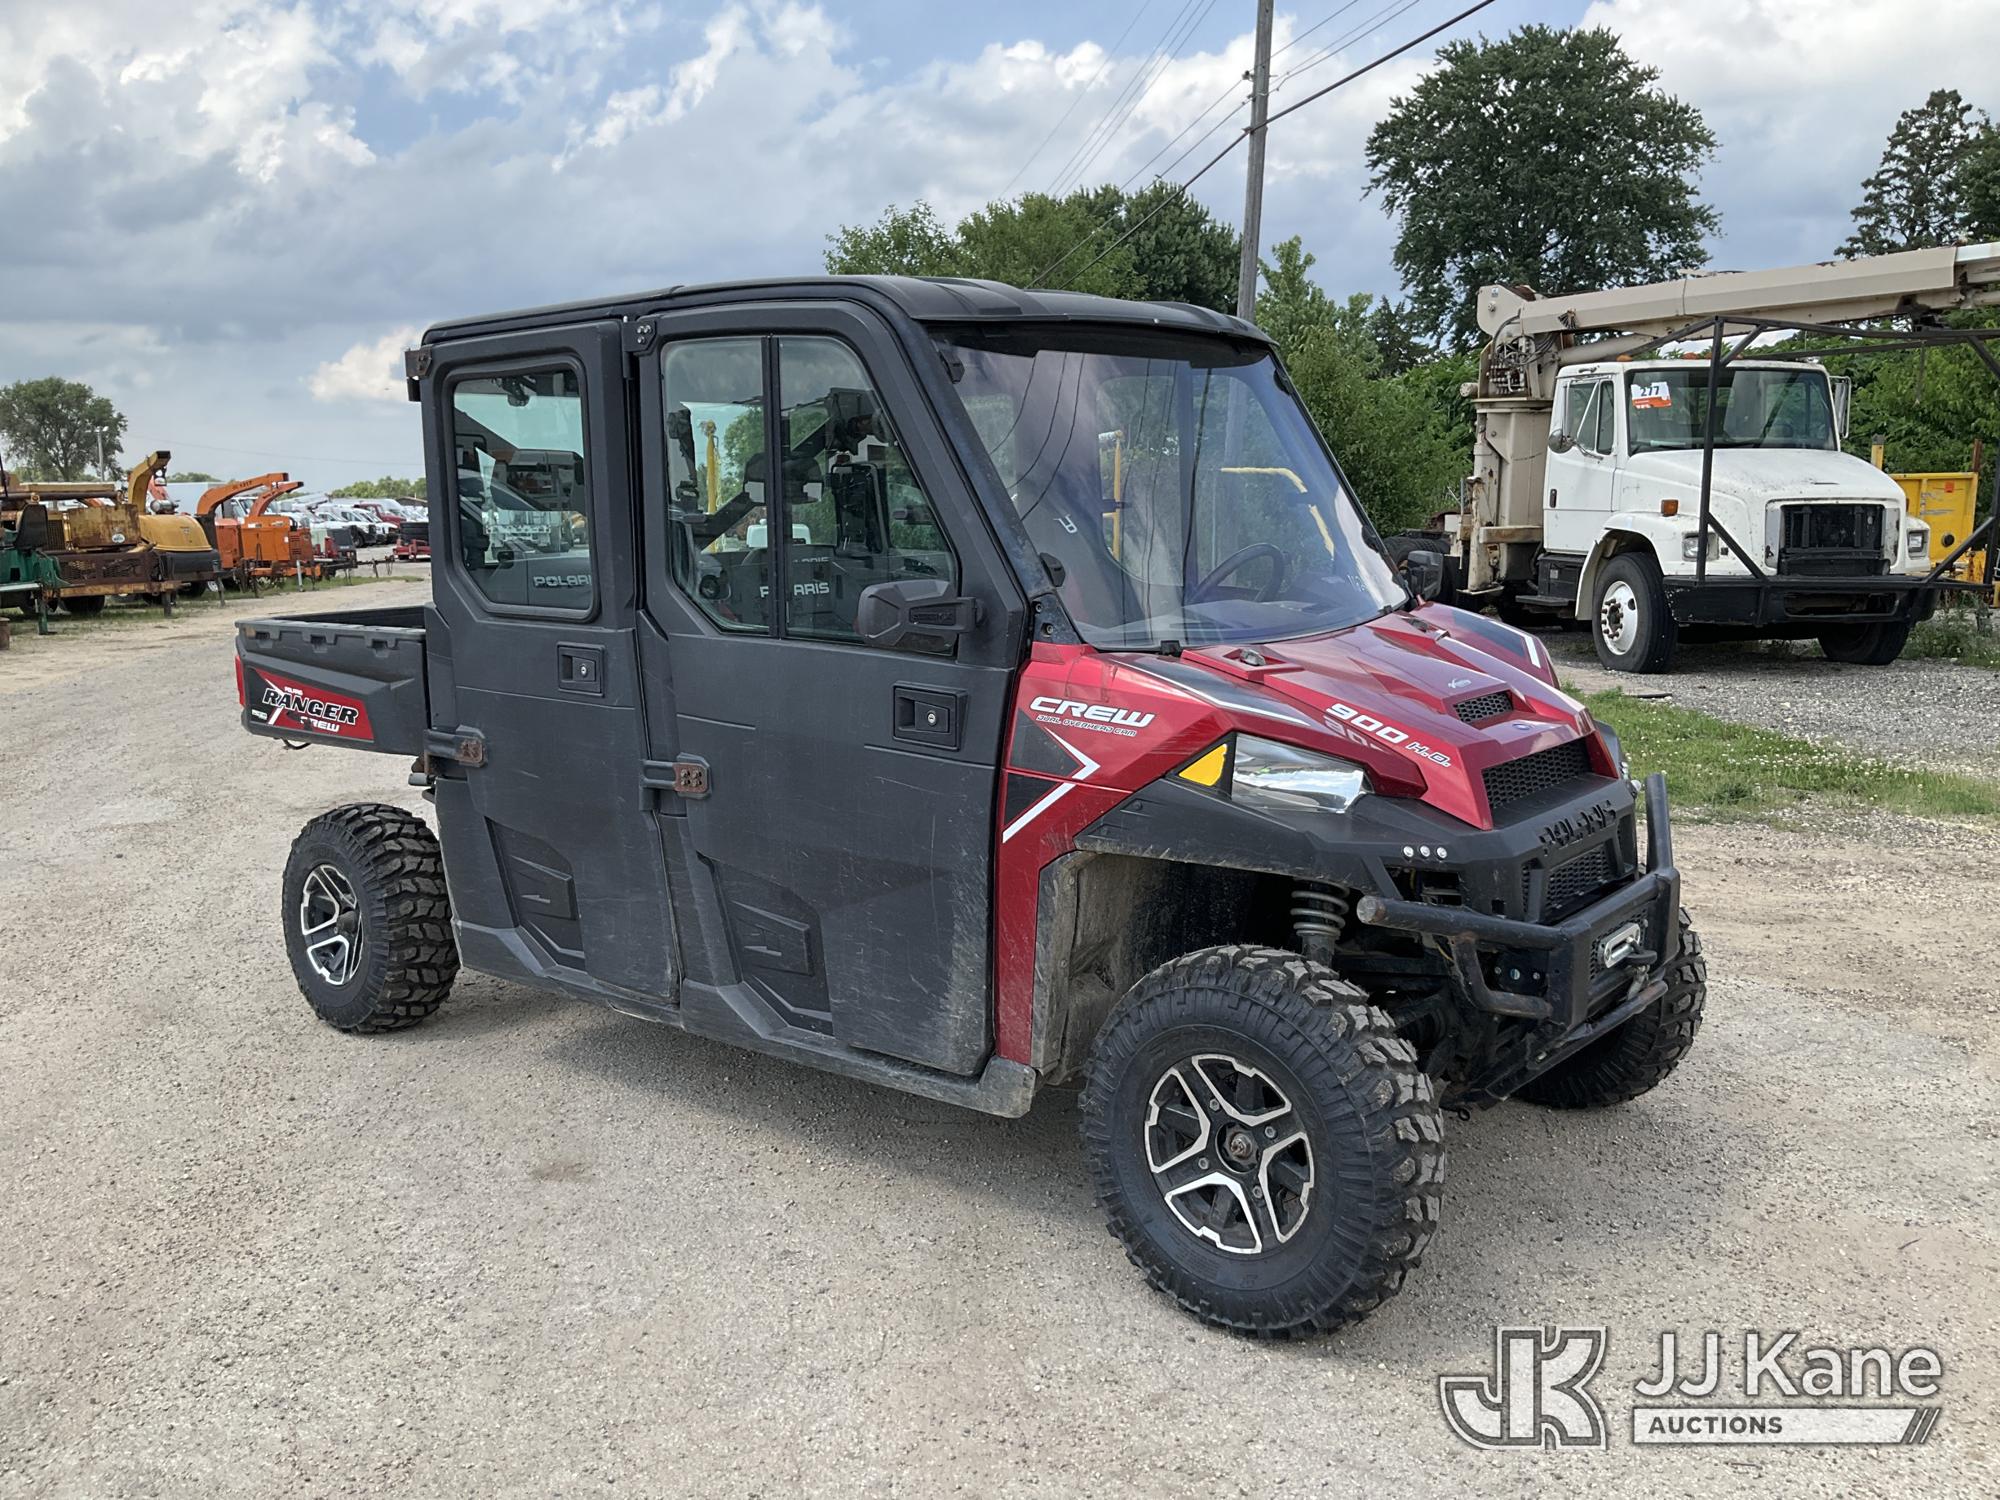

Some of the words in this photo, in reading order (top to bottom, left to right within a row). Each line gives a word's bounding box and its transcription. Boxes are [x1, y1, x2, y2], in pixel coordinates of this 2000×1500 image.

[1640, 386, 1660, 397] 277
[533, 574, 593, 588] POLARI
[759, 582, 831, 598] PARIS
[262, 687, 359, 725] RANGER
[1029, 696, 1156, 728] CREW
[1035, 714, 1062, 725] DUAL
[1062, 718, 1114, 733] OVERHEAD
[1113, 727, 1138, 738] CAM
[1325, 703, 1409, 744] 900
[1538, 799, 1617, 856] POLARIS
